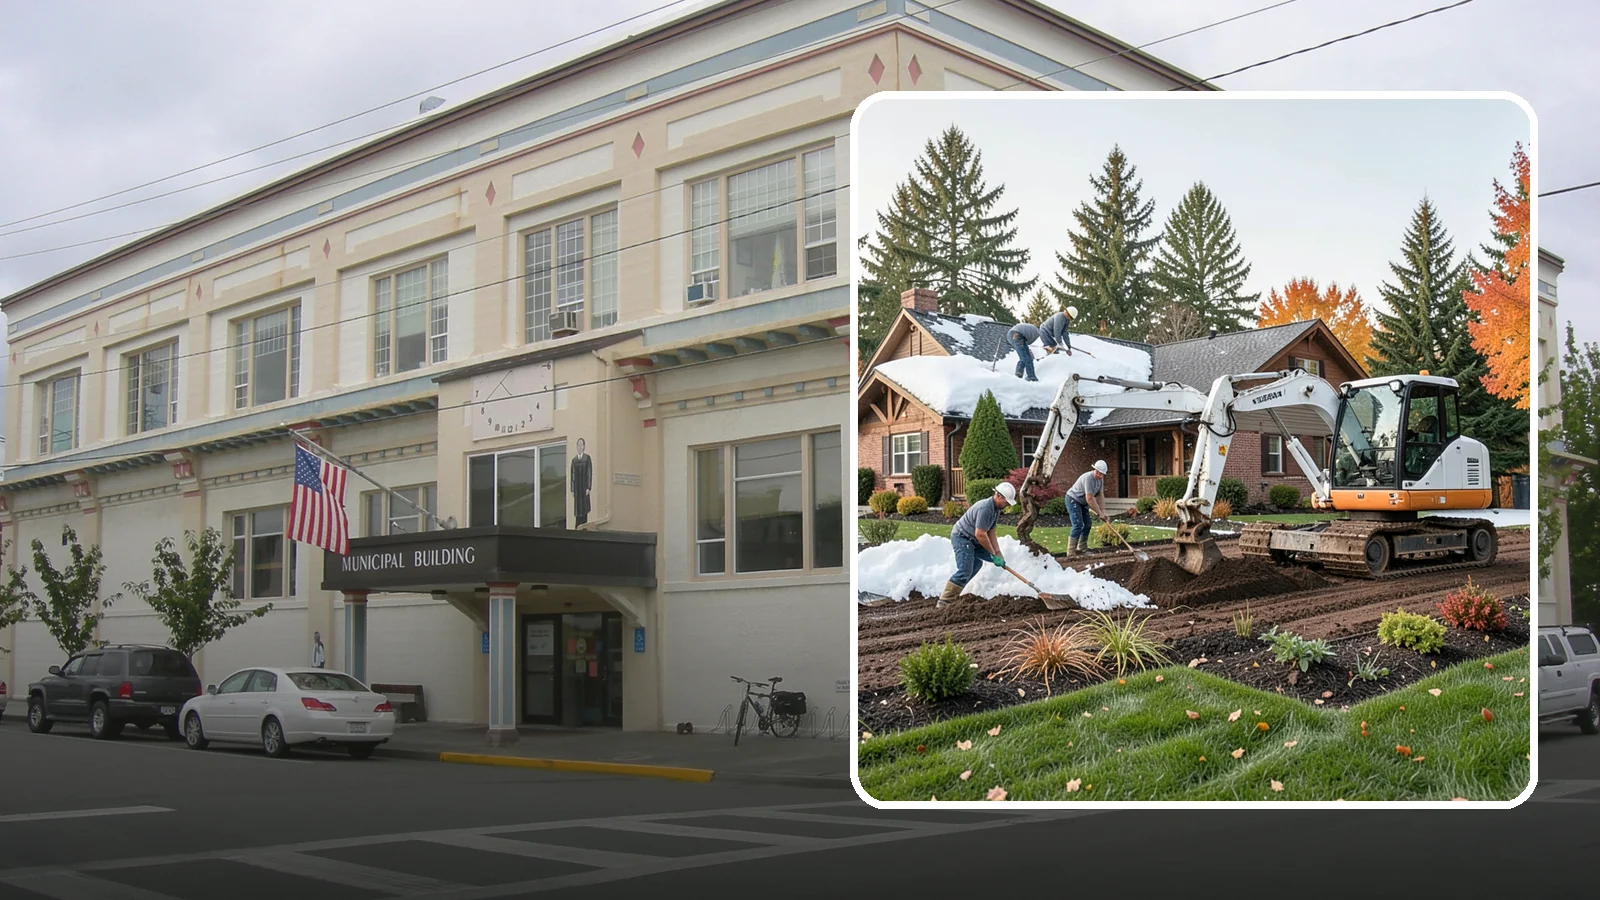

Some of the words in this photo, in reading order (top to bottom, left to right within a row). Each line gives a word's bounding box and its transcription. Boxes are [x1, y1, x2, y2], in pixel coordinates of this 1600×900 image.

[536, 402, 540, 410] 4
[480, 406, 485, 416] 8
[488, 418, 492, 426] 9
[528, 414, 533, 422] 3
[494, 424, 500, 432] 10
[521, 420, 526, 428] 2
[508, 426, 514, 434] 12
[342, 552, 406, 572] MUNICIPAL
[414, 546, 475, 567] BUILDING
